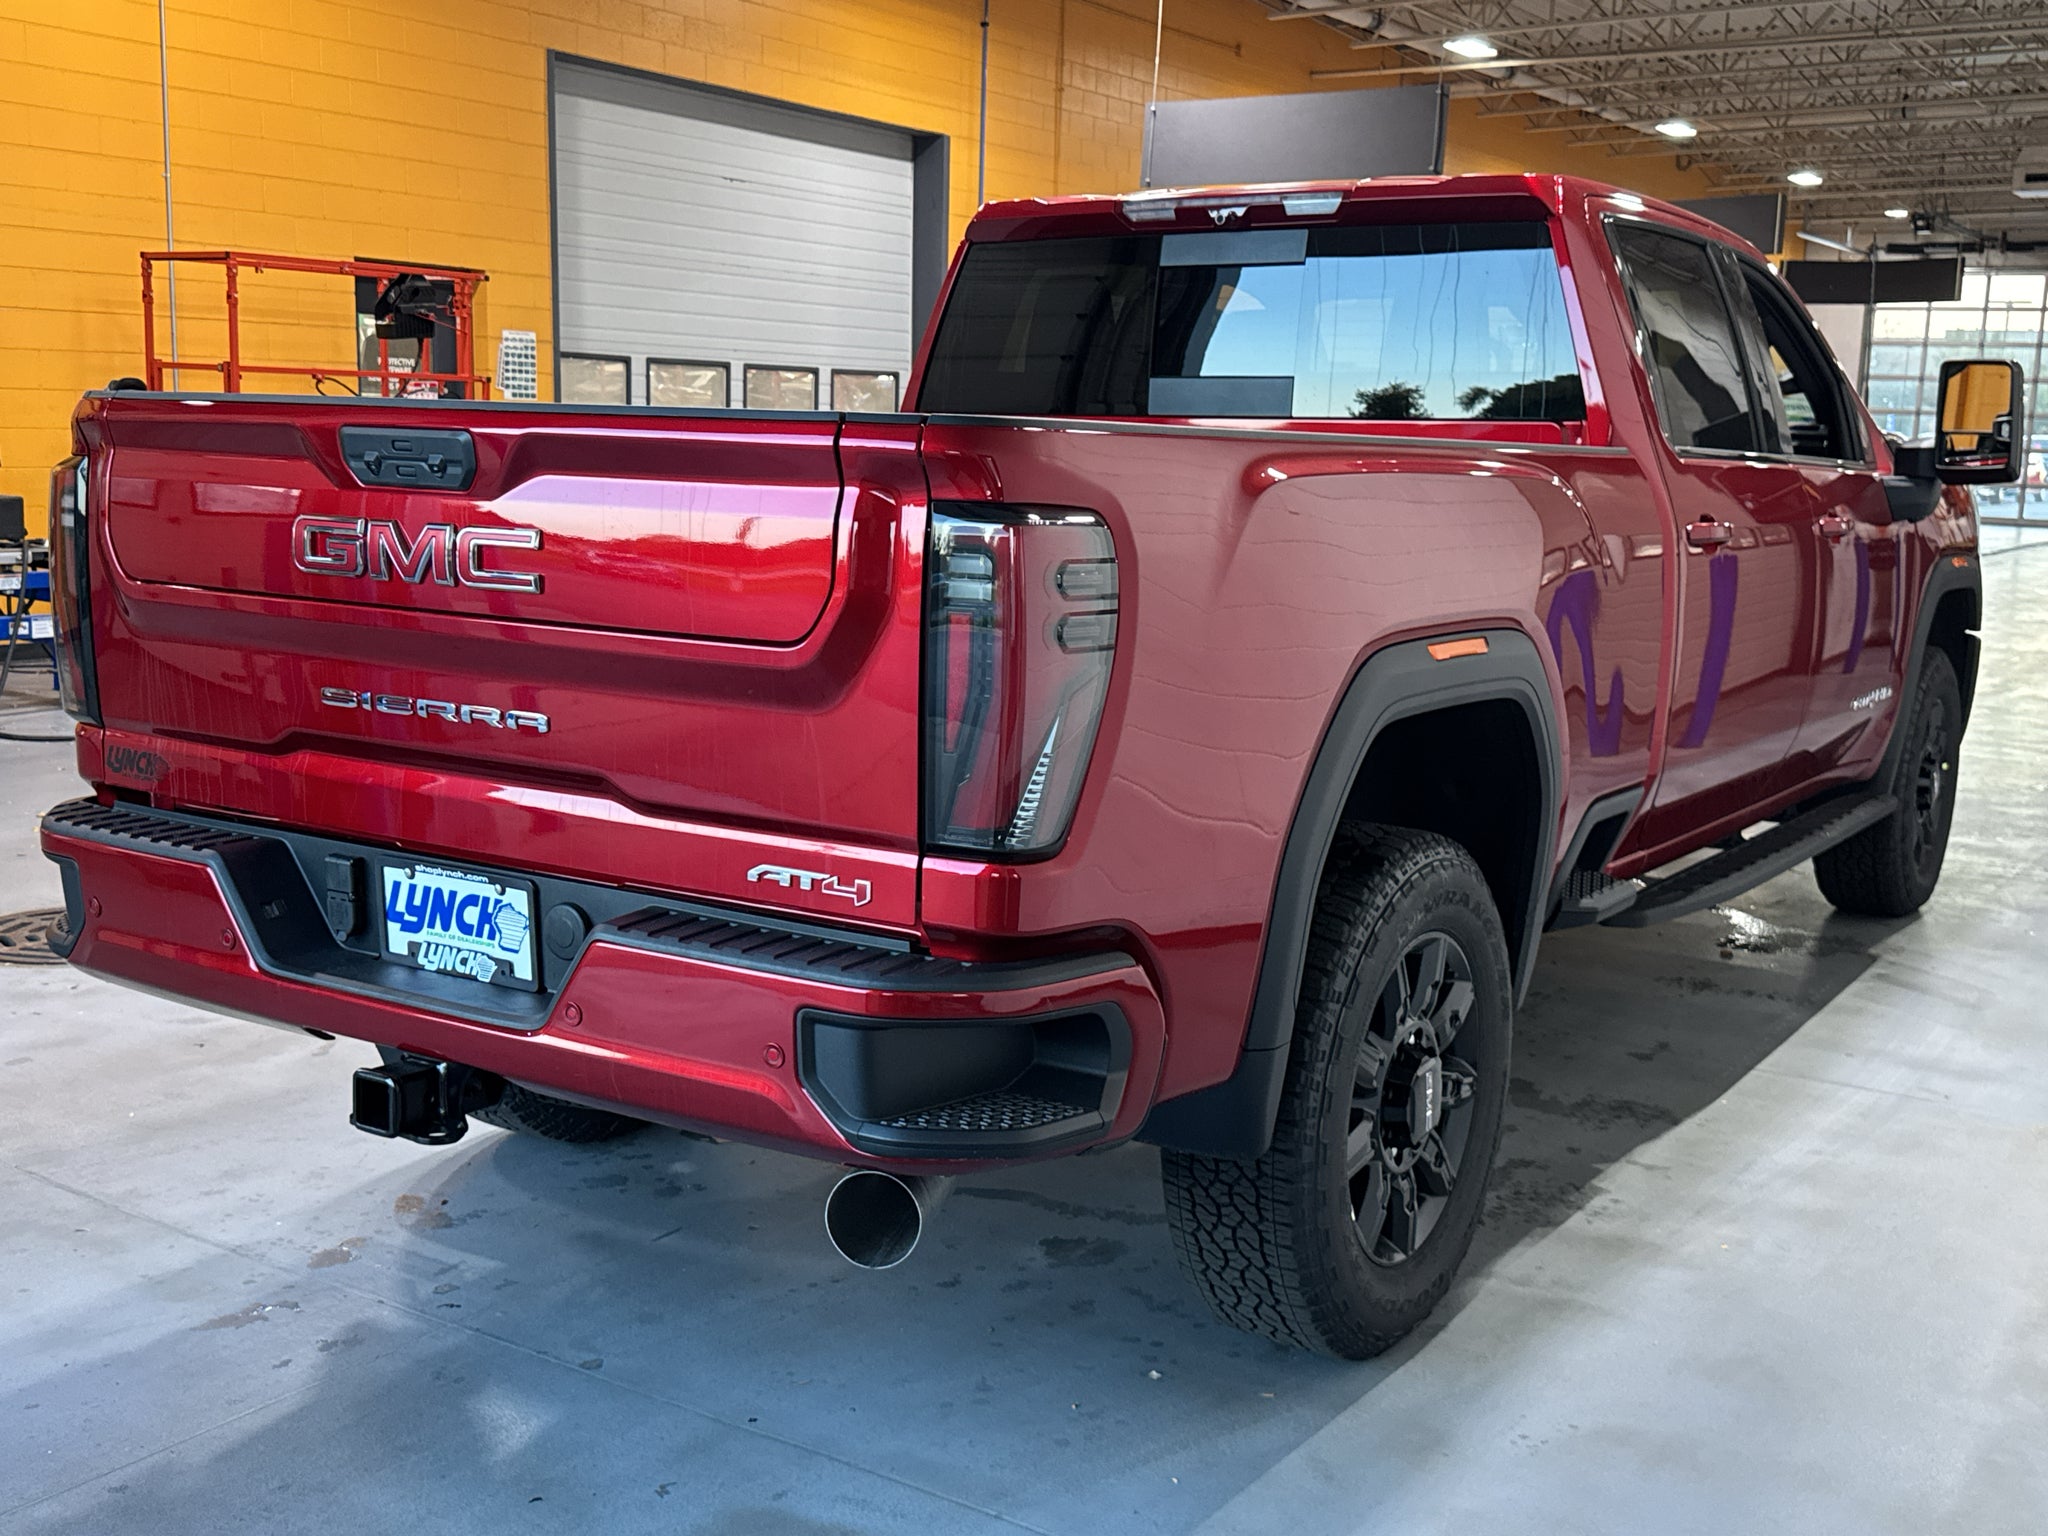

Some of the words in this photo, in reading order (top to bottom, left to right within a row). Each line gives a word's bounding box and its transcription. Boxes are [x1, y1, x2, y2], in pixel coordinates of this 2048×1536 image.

[292, 514, 543, 594] GMC
[320, 686, 550, 733] SIERRA
[106, 745, 157, 776] LYNCH
[415, 864, 489, 883] shoplynch.com
[747, 864, 872, 907] AT4
[386, 880, 503, 941] LYNCH
[417, 941, 482, 976] LYNCH
